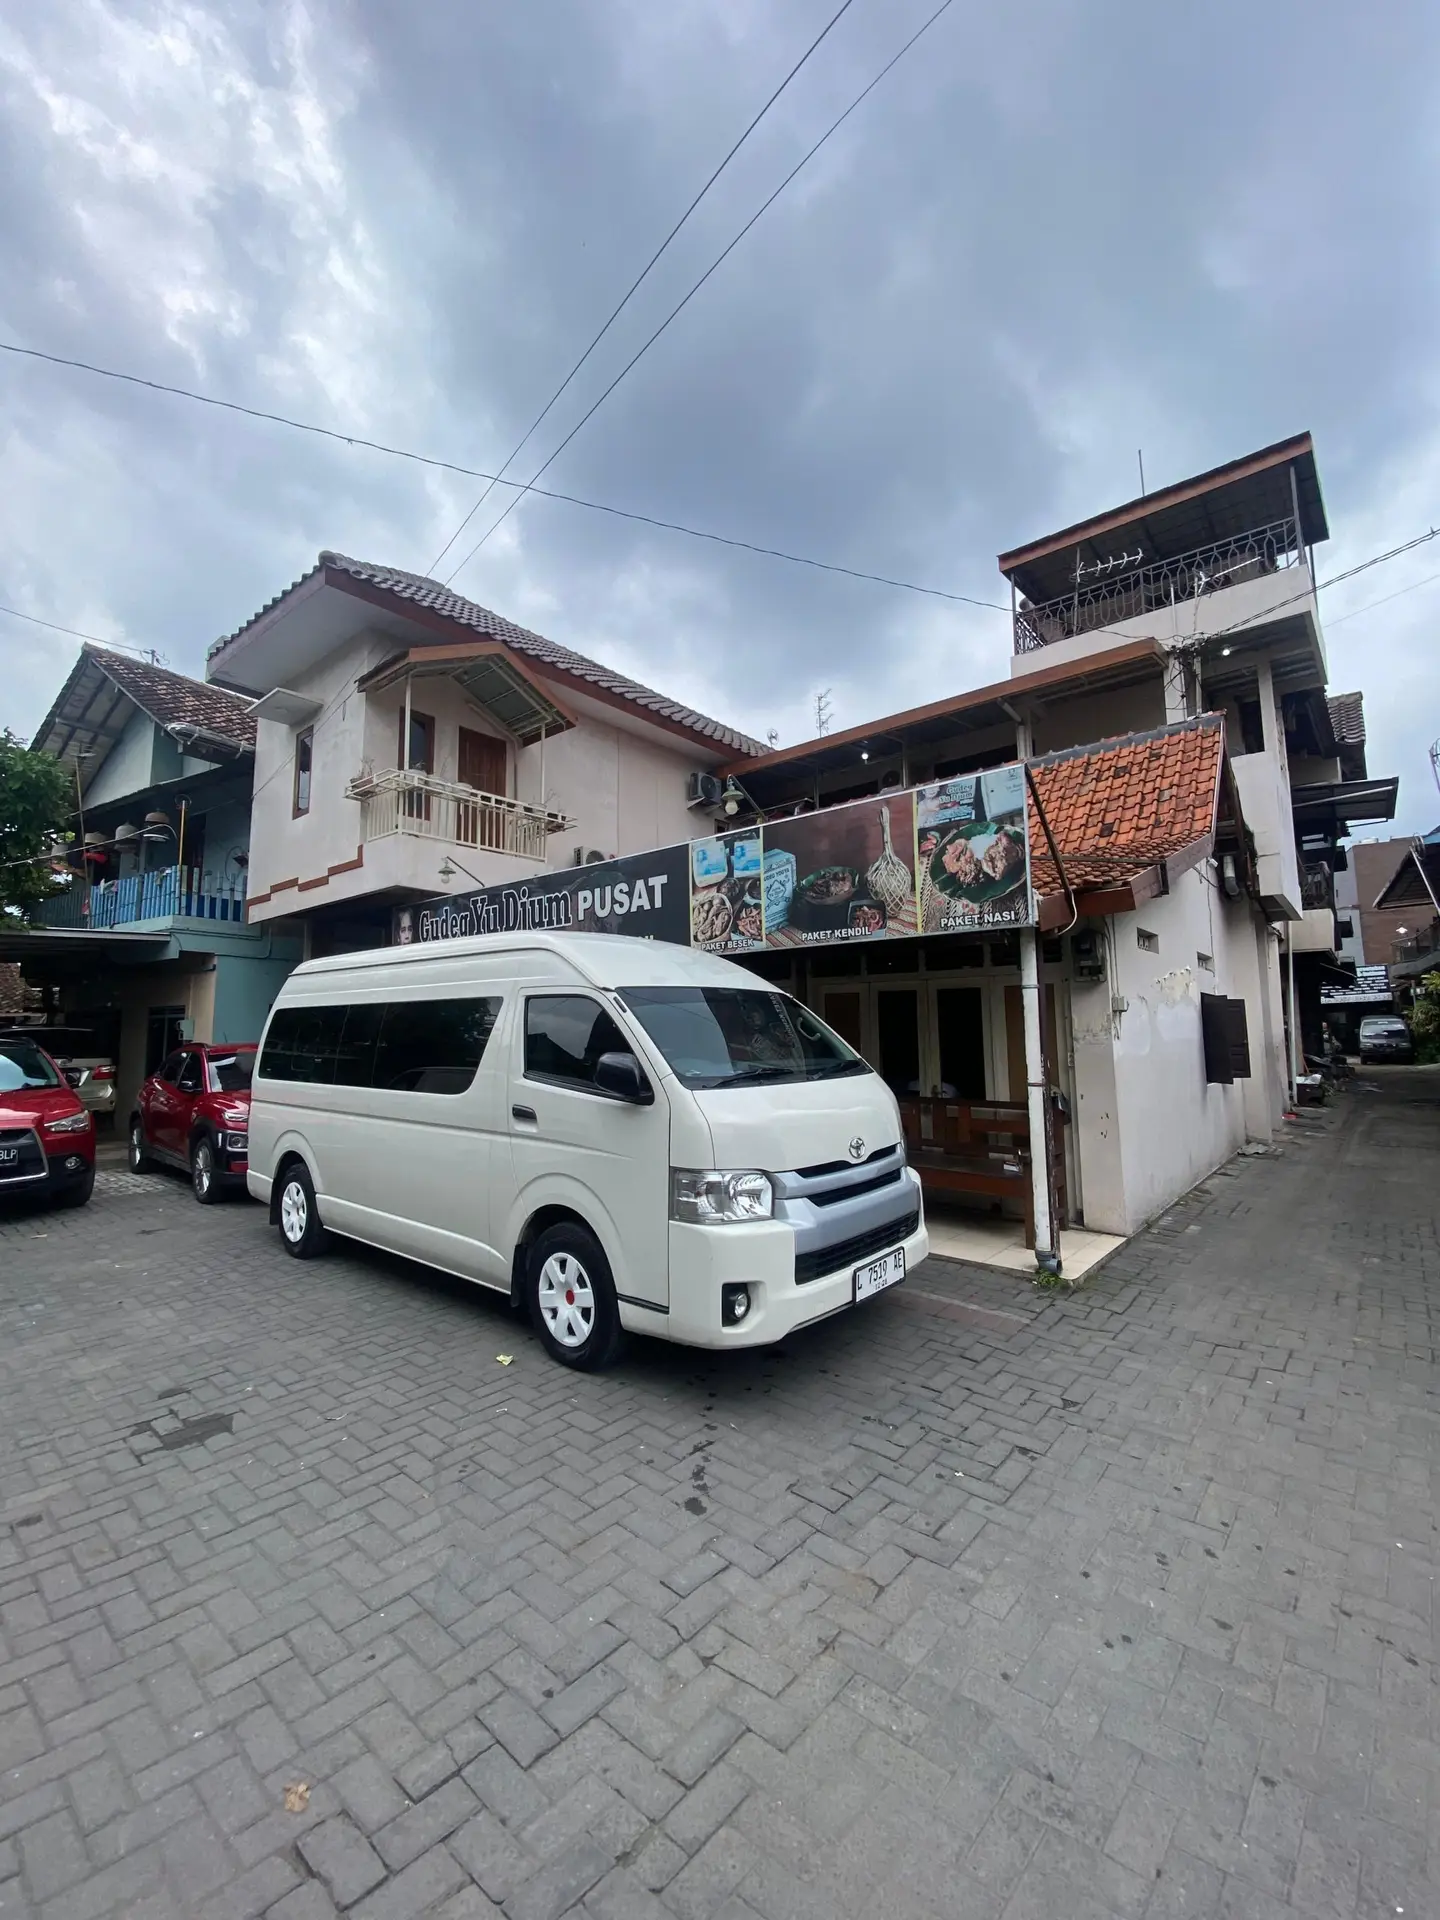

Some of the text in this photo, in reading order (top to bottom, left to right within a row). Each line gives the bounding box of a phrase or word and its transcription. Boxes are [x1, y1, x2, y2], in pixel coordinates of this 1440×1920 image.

[419, 907, 469, 942] Gudeg
[470, 896, 500, 935] Yu
[578, 874, 668, 921] PUSAT
[940, 910, 1015, 928] PAKET NASI
[801, 926, 872, 941] PAKET KENDIL
[701, 938, 754, 951] PAKET BESEK
[858, 1252, 902, 1291] L 7519 AE
